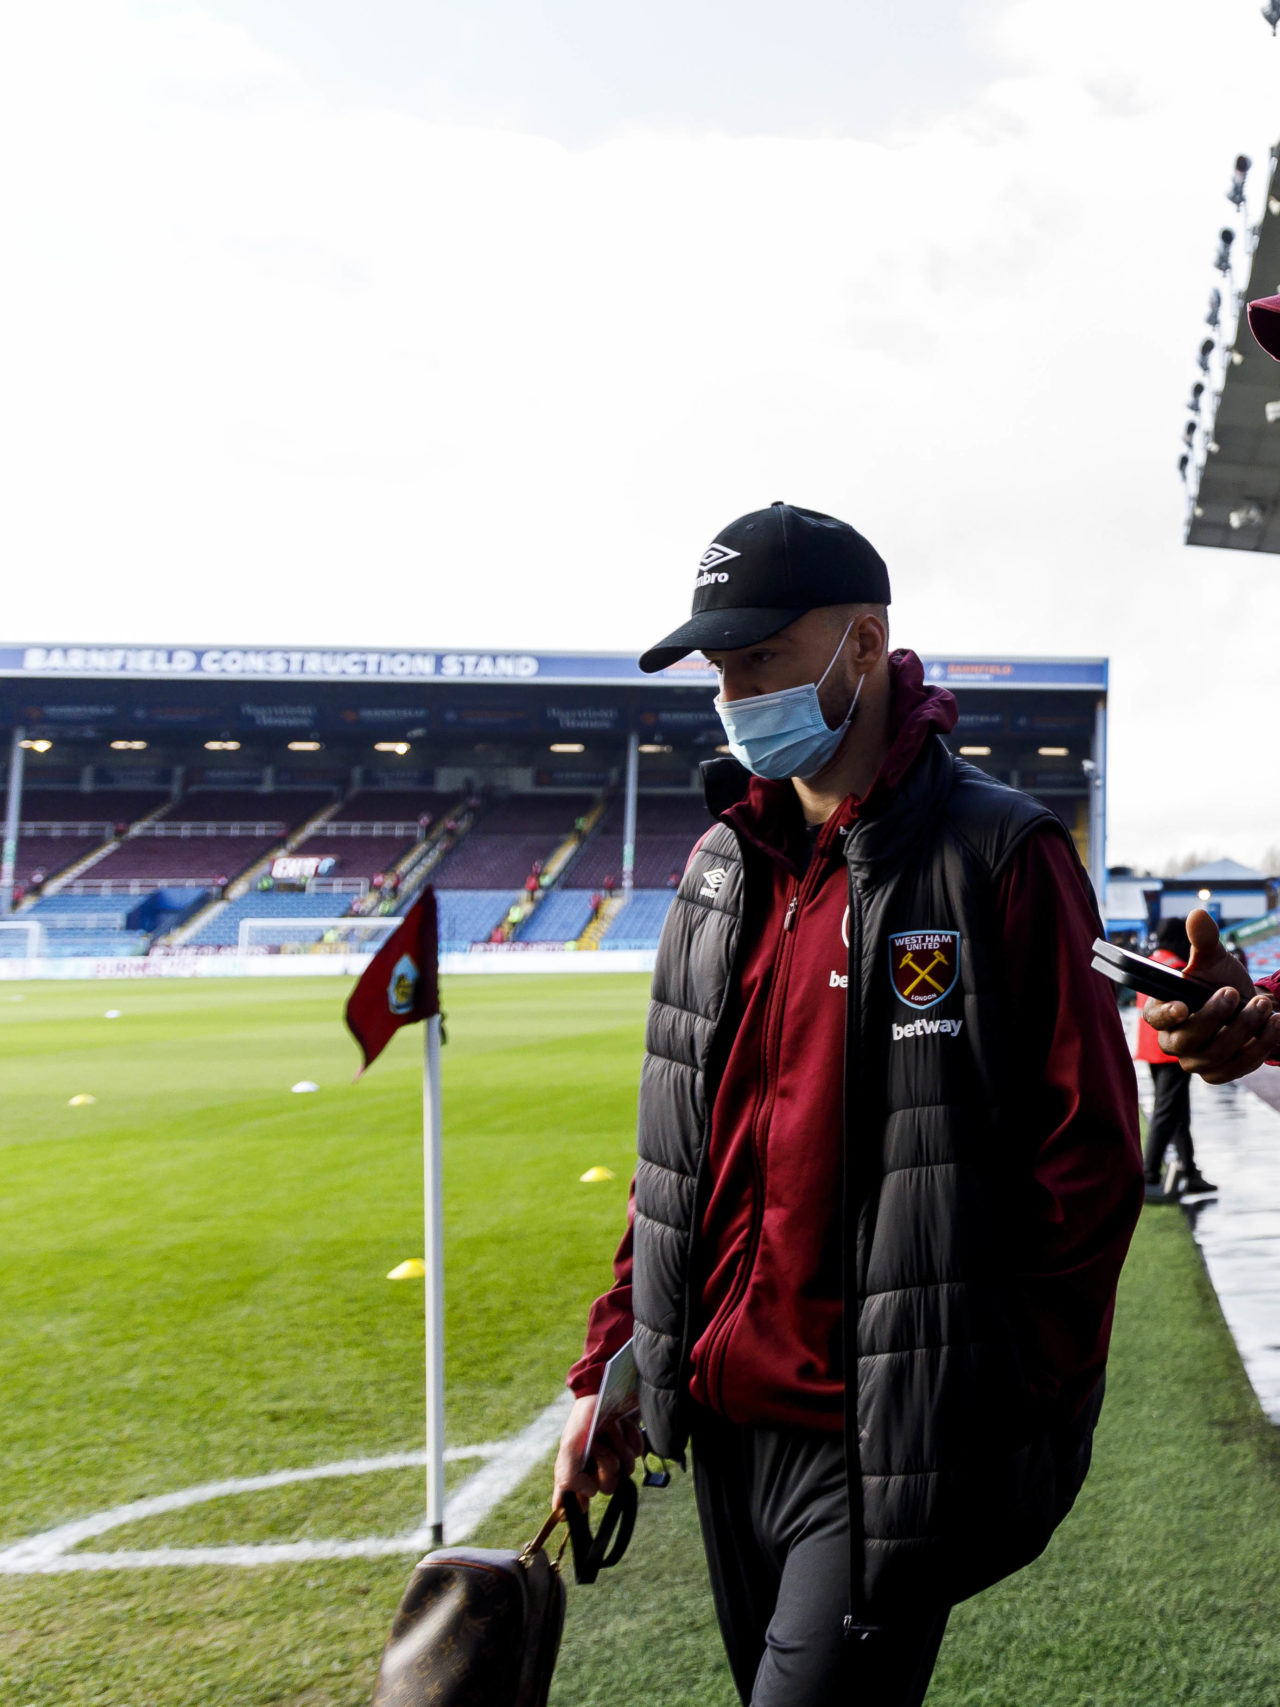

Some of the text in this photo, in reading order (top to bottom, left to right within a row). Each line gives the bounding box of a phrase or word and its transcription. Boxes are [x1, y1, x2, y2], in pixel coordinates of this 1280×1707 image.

[23, 648, 540, 677] BARNFIELD CONSTRUCTION STAND
[895, 934, 952, 947] WEST HAM
[906, 943, 940, 951] UNITED
[910, 993, 937, 1002] LONDON
[892, 1019, 963, 1041] betway
